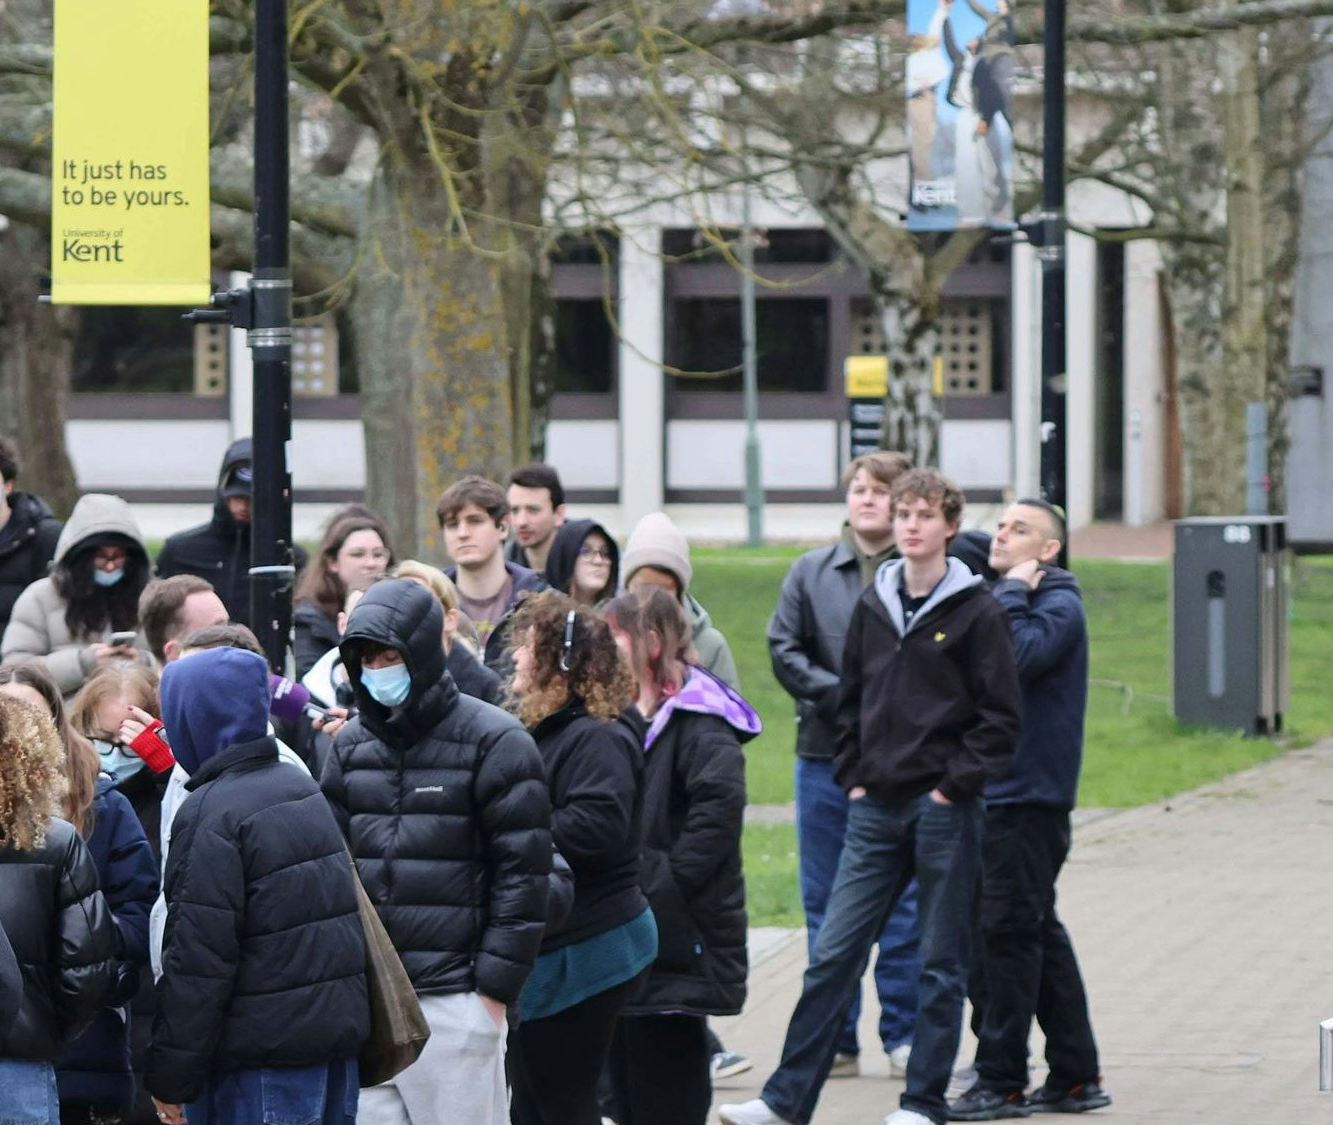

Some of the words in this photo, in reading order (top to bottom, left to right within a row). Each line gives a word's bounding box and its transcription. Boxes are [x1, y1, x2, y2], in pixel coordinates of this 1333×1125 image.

[62, 159, 77, 180] It
[81, 159, 123, 185] just
[129, 159, 167, 180] has
[62, 187, 83, 206] to
[91, 186, 117, 206] be
[123, 189, 189, 210] yours.
[62, 228, 110, 240] University
[113, 228, 124, 238] of
[62, 239, 124, 262] Kent
